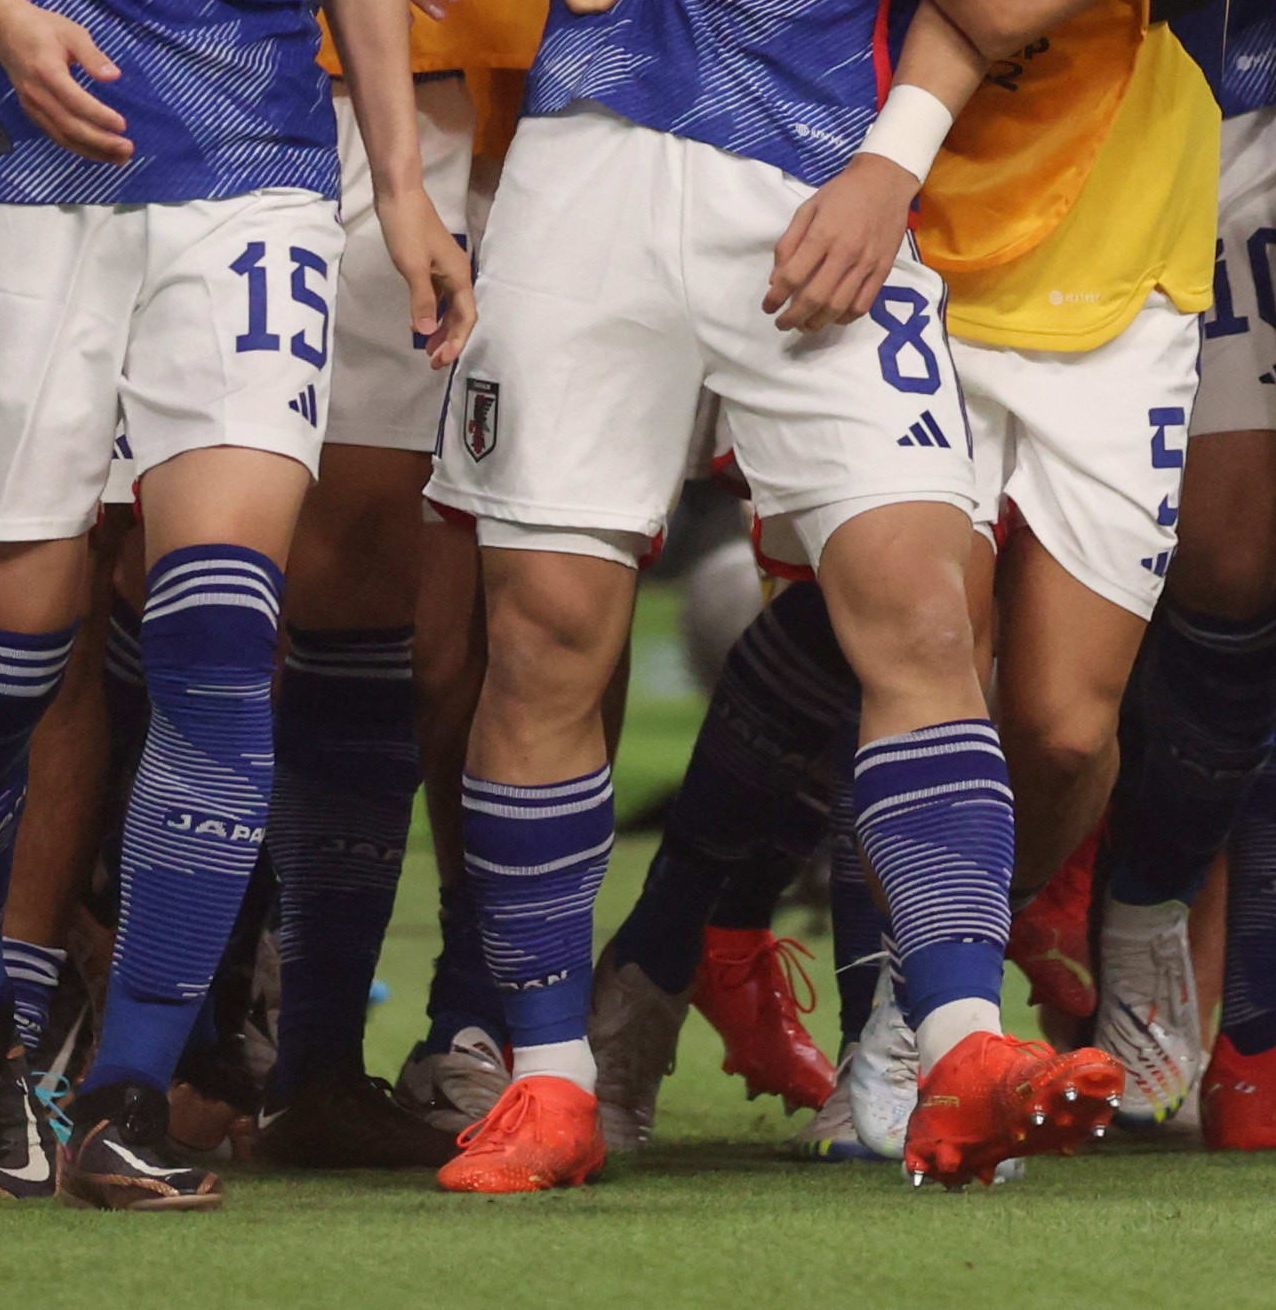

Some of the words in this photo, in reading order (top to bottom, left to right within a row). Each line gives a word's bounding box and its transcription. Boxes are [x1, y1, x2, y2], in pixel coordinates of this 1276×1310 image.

[228, 241, 329, 371] 15
[869, 285, 942, 396] 8
[166, 813, 266, 843] JAPA
